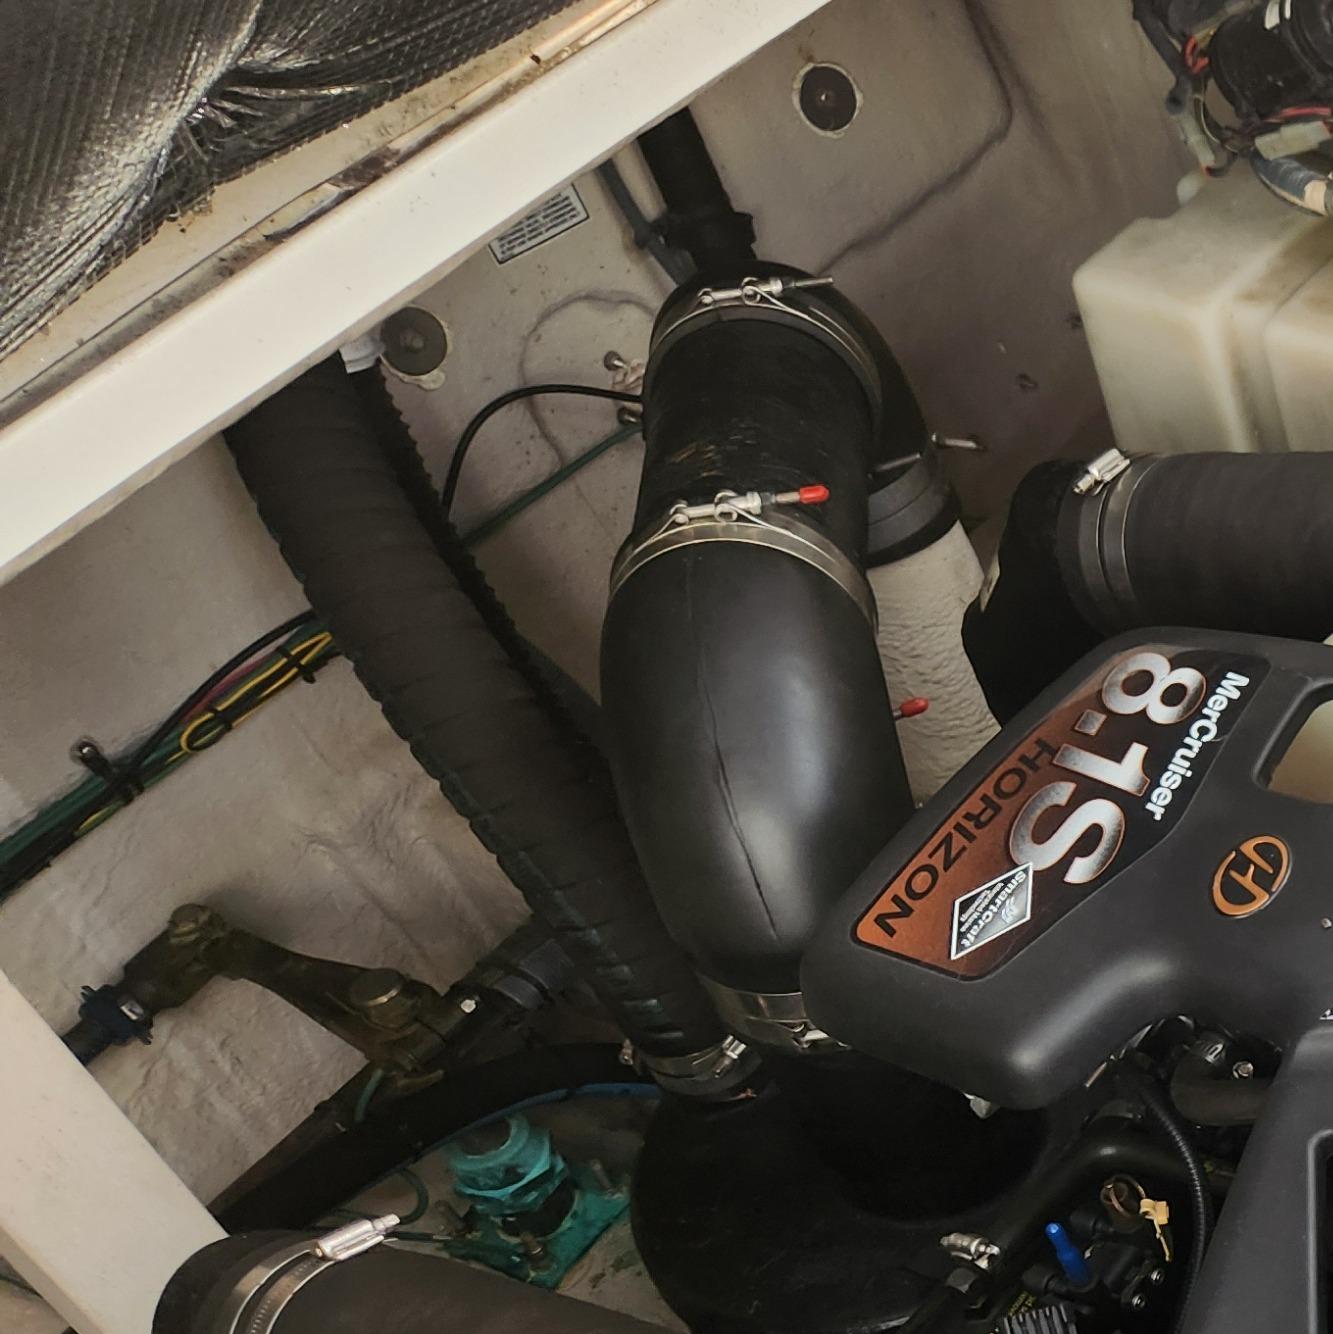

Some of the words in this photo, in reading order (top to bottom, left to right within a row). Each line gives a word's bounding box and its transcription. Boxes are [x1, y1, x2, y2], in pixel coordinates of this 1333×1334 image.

[873, 737, 1062, 938] HORIZON
[1008, 651, 1208, 885] 8.1S
[1144, 670, 1251, 821] MerCruiser
